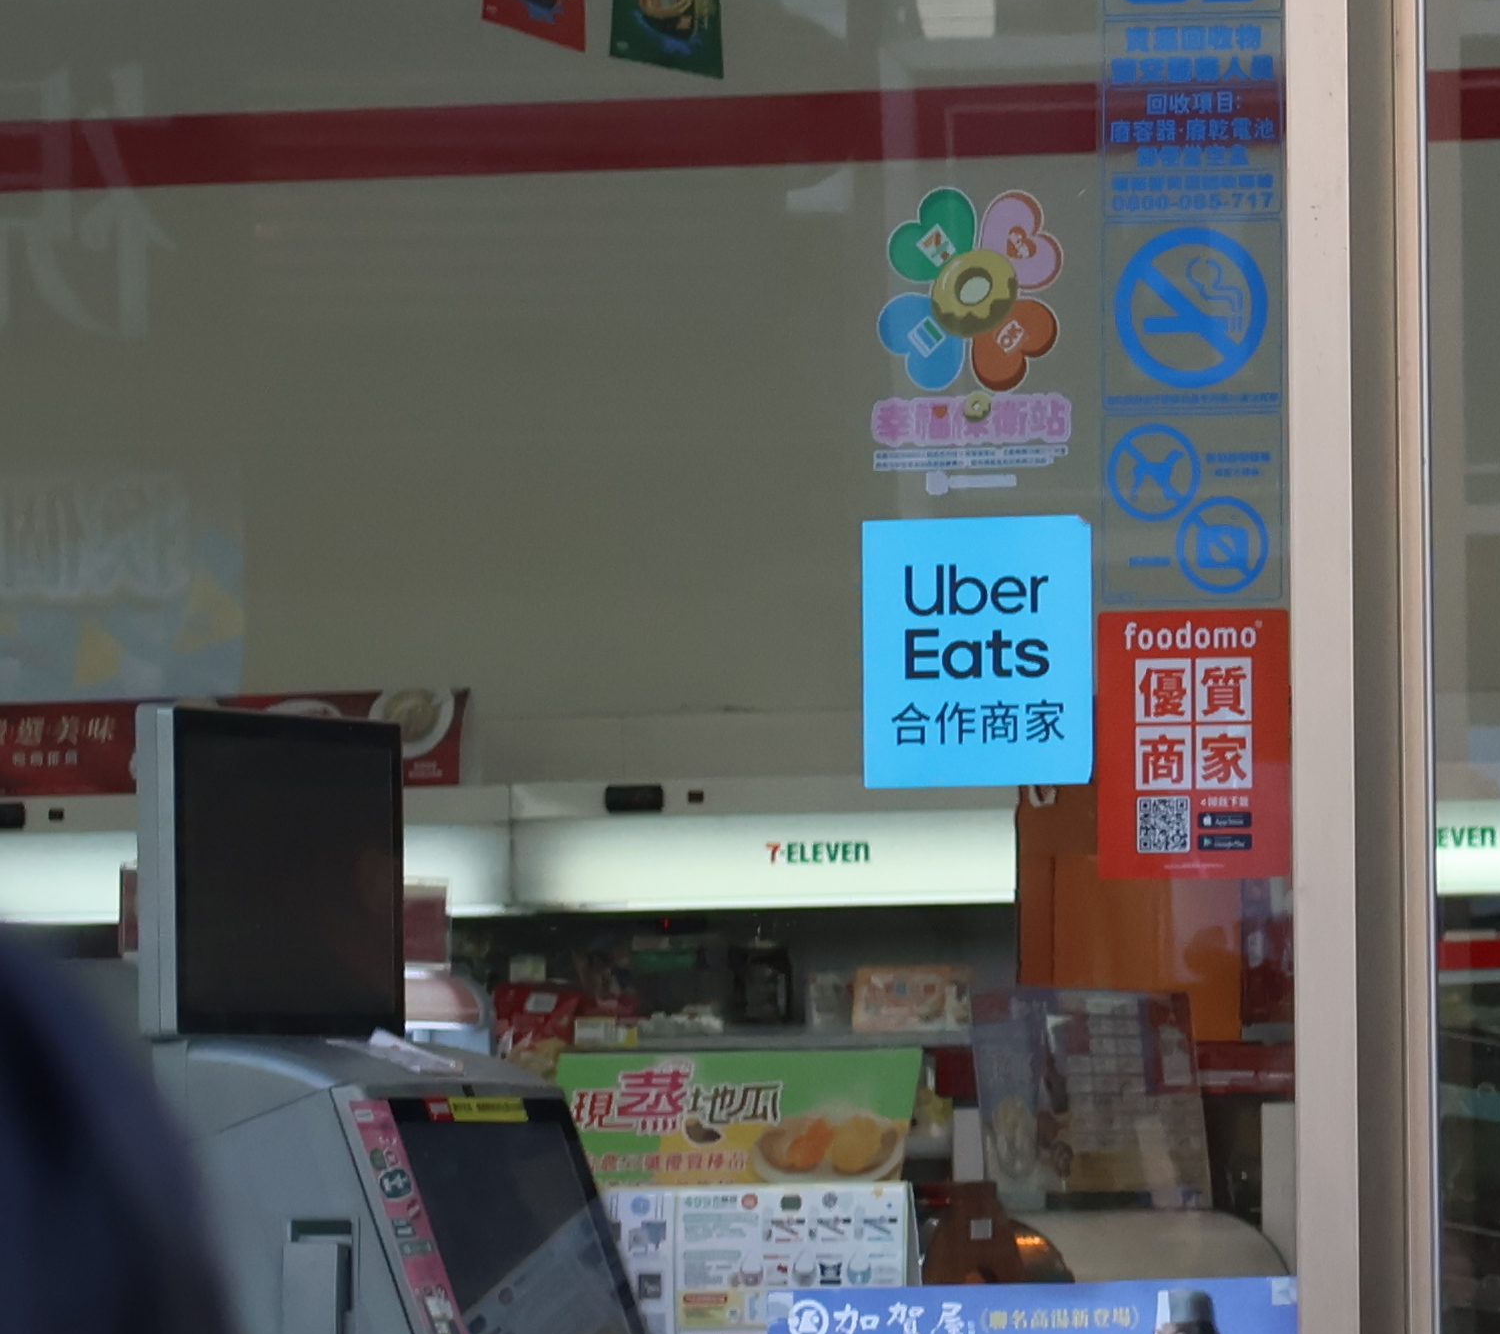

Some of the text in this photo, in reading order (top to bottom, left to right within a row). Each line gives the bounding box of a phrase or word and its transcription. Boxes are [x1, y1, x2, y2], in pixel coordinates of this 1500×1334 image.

[904, 564, 1049, 616] Uber
[904, 629, 1050, 681] Eats
[1124, 620, 1258, 650] foodomo
[890, 699, 1066, 745] 合作商家
[570, 1069, 785, 1137] 現蒸地瓜
